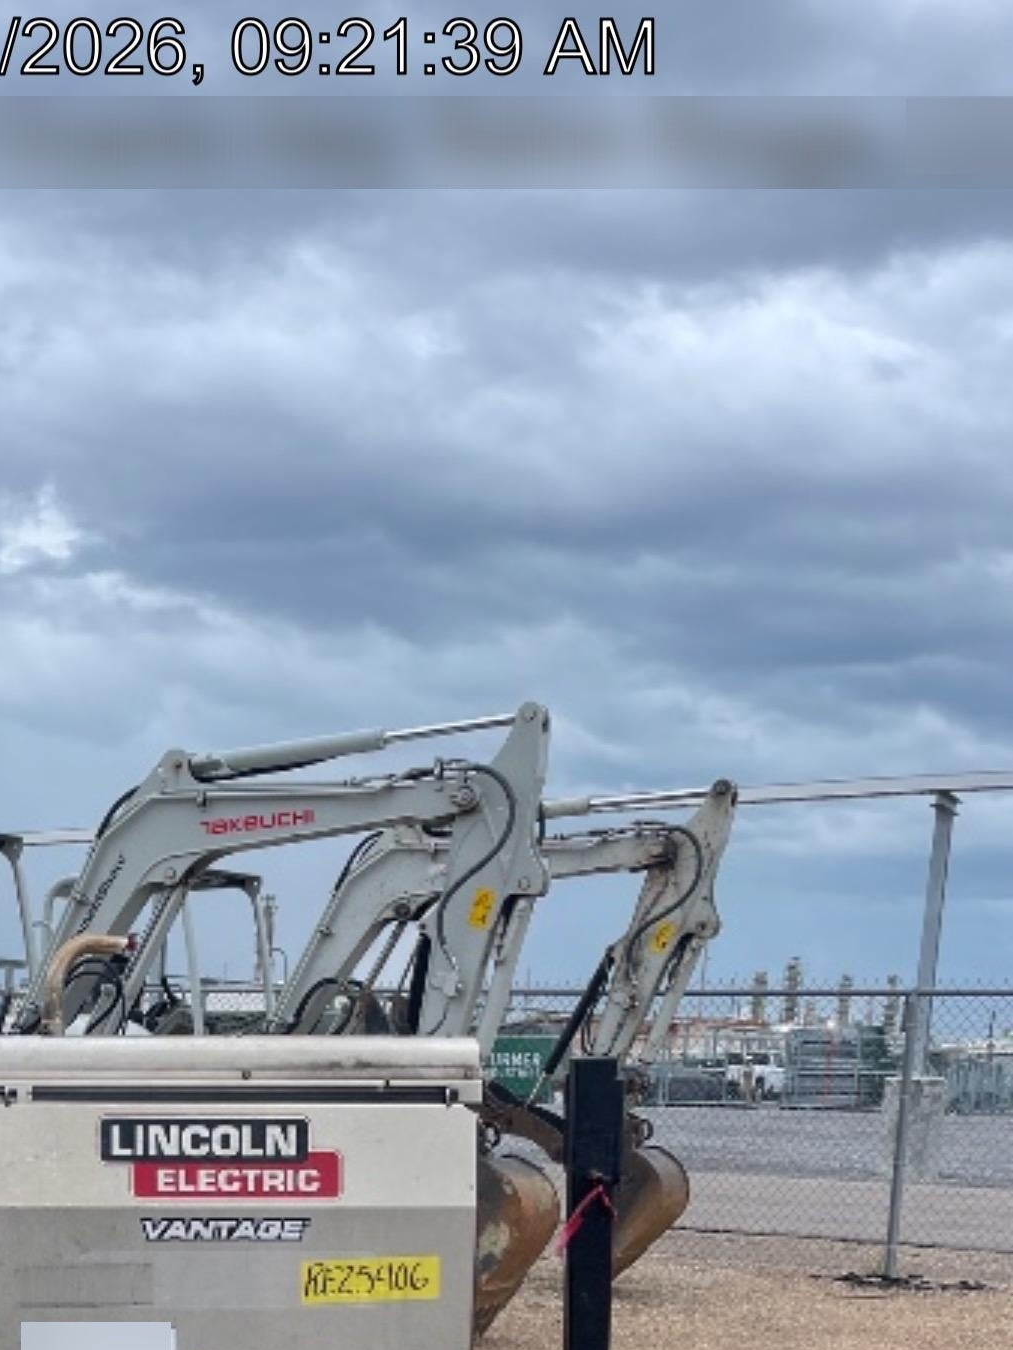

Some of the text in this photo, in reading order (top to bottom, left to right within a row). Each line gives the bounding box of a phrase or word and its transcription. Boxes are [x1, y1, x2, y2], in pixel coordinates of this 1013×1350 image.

[111, 1124, 298, 1156] LINCOLN
[156, 1169, 321, 1192] ELECTRIC
[142, 1218, 308, 1241] VANTAGE
[304, 1262, 430, 1298] RE25406
